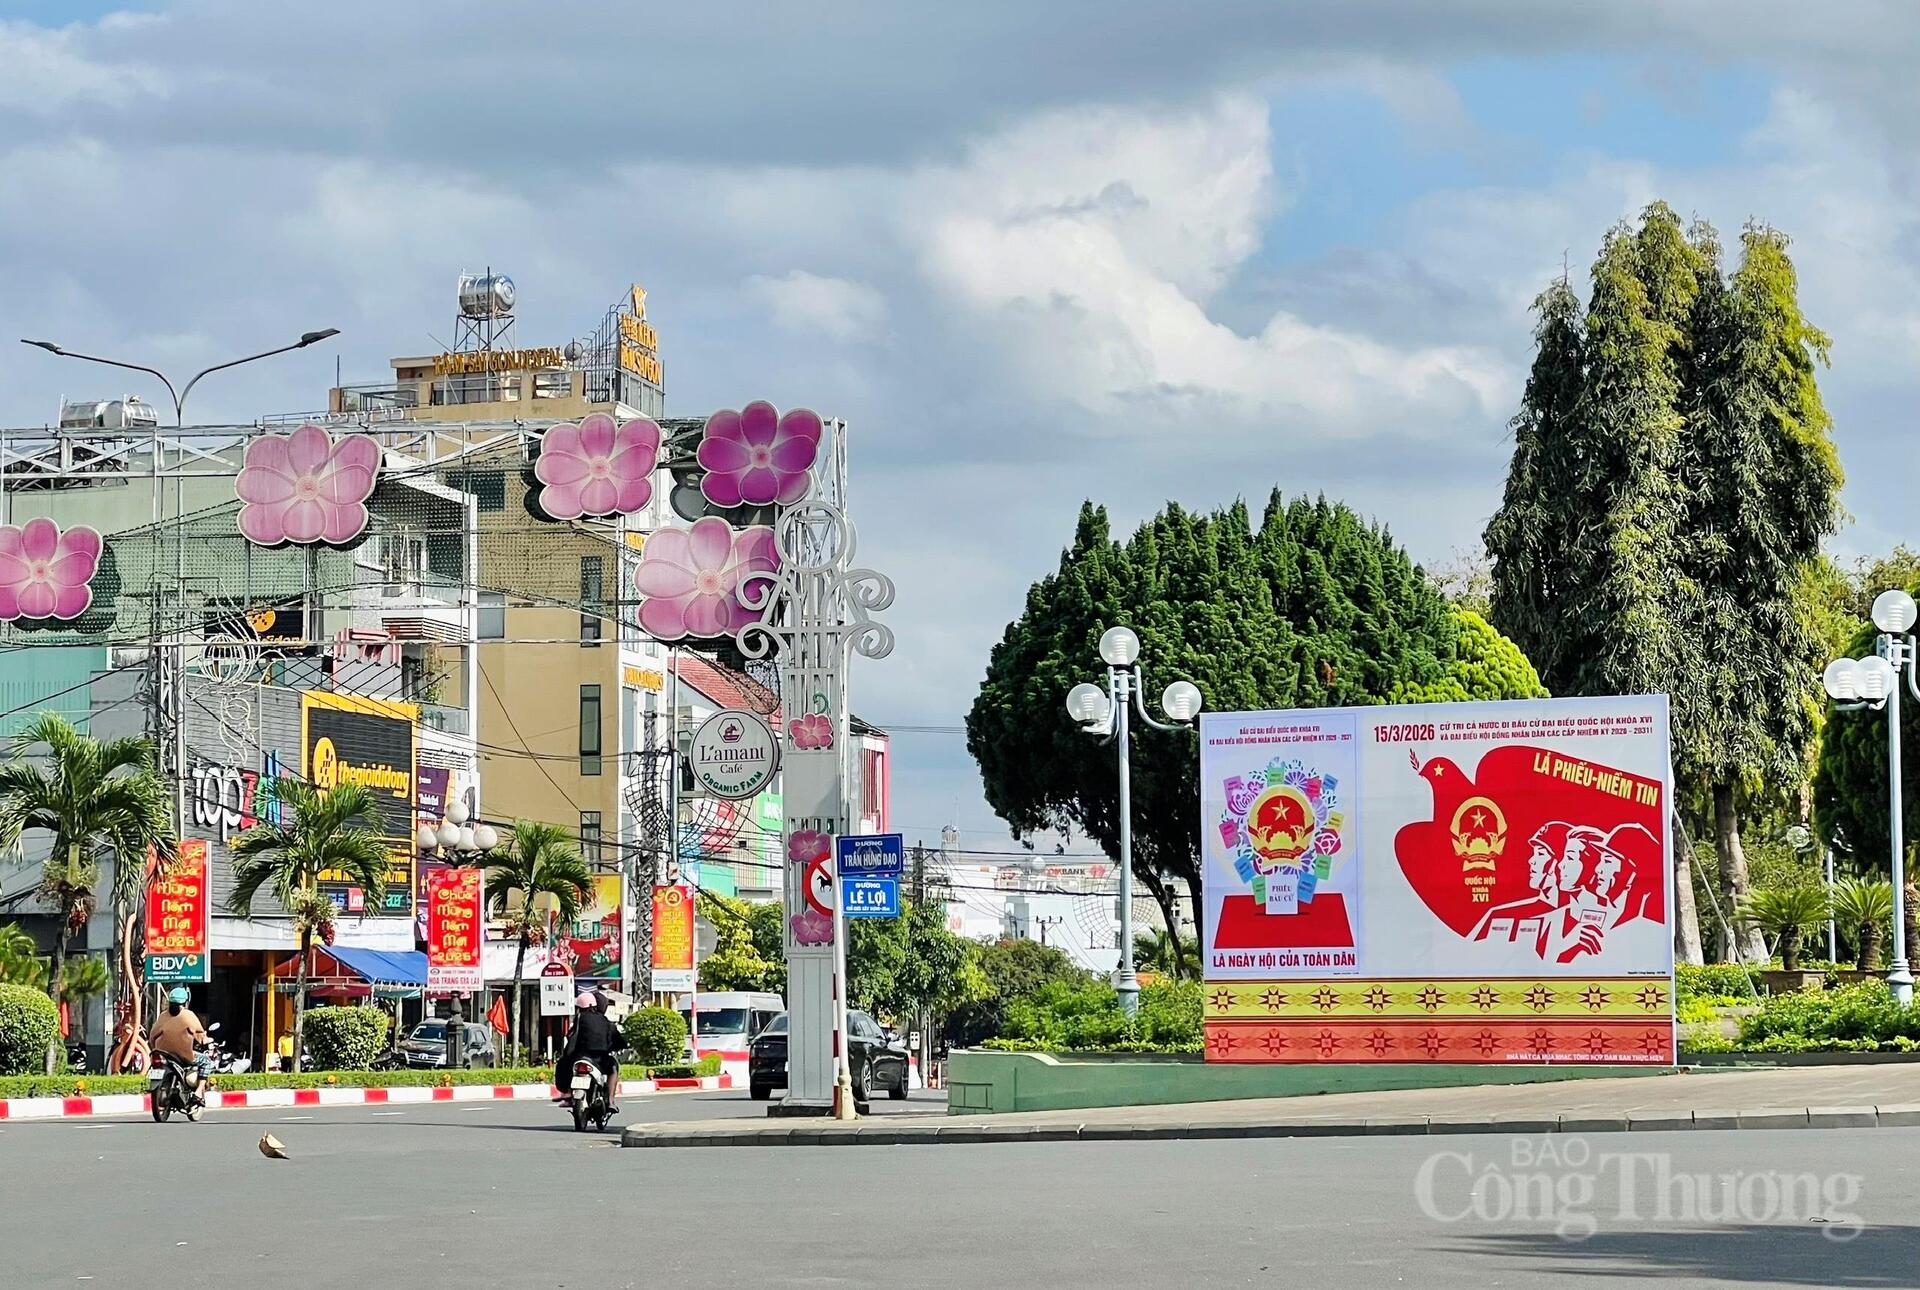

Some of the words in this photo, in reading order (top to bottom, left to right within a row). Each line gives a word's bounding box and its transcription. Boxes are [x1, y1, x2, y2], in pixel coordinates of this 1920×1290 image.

[516, 347, 562, 369] DENTAL
[1440, 721, 1450, 731] CỬ
[1466, 720, 1477, 730] CẢ
[1479, 719, 1499, 729] NƯỚC
[1512, 719, 1527, 728] BẦU
[1530, 718, 1540, 728] CỬ
[1542, 719, 1555, 729] ĐẠI
[1557, 717, 1575, 727] BIỂU
[1577, 717, 1598, 727] QUỐC
[1600, 715, 1614, 726] HỘI
[1616, 714, 1637, 724] KHÓA
[1374, 724, 1435, 742] 15/3/2026
[1450, 733, 1462, 741] ĐẠI
[1463, 731, 1478, 740] BIỂU
[1480, 731, 1490, 741] HỘI
[1492, 730, 1510, 739] ĐỒNG
[1511, 730, 1530, 739] NHÂN
[1532, 729, 1546, 738] DÂN
[1547, 729, 1560, 737] CÁC
[1562, 727, 1575, 737] CẤP
[1577, 727, 1599, 738] NHIỆM
[699, 745, 766, 761] L'amant
[720, 763, 743, 774] Café
[338, 760, 411, 798] thegioididong
[740, 770, 764, 791] FARM
[1533, 752, 1551, 776] LÁ
[1635, 782, 1658, 807] TIN
[844, 850, 862, 867] TRẦN
[862, 851, 882, 867] HƯNG
[882, 852, 897, 868] ĐẠO
[1464, 876, 1482, 886] QUỐC
[1484, 875, 1496, 886] HỘI
[386, 894, 403, 907] acer
[850, 889, 864, 904] LÊ
[867, 890, 886, 907] LỢI
[1472, 893, 1489, 902] XVI
[157, 936, 195, 947] 2026
[152, 957, 187, 971] BIDV
[437, 952, 471, 961] 2026
[1213, 952, 1225, 967] LÀ
[1228, 952, 1255, 967] NGÀY
[1259, 952, 1276, 969] HỘI
[1279, 949, 1299, 967] CỦA
[1303, 951, 1331, 967] TOÀN
[1333, 951, 1355, 966] DÂN
